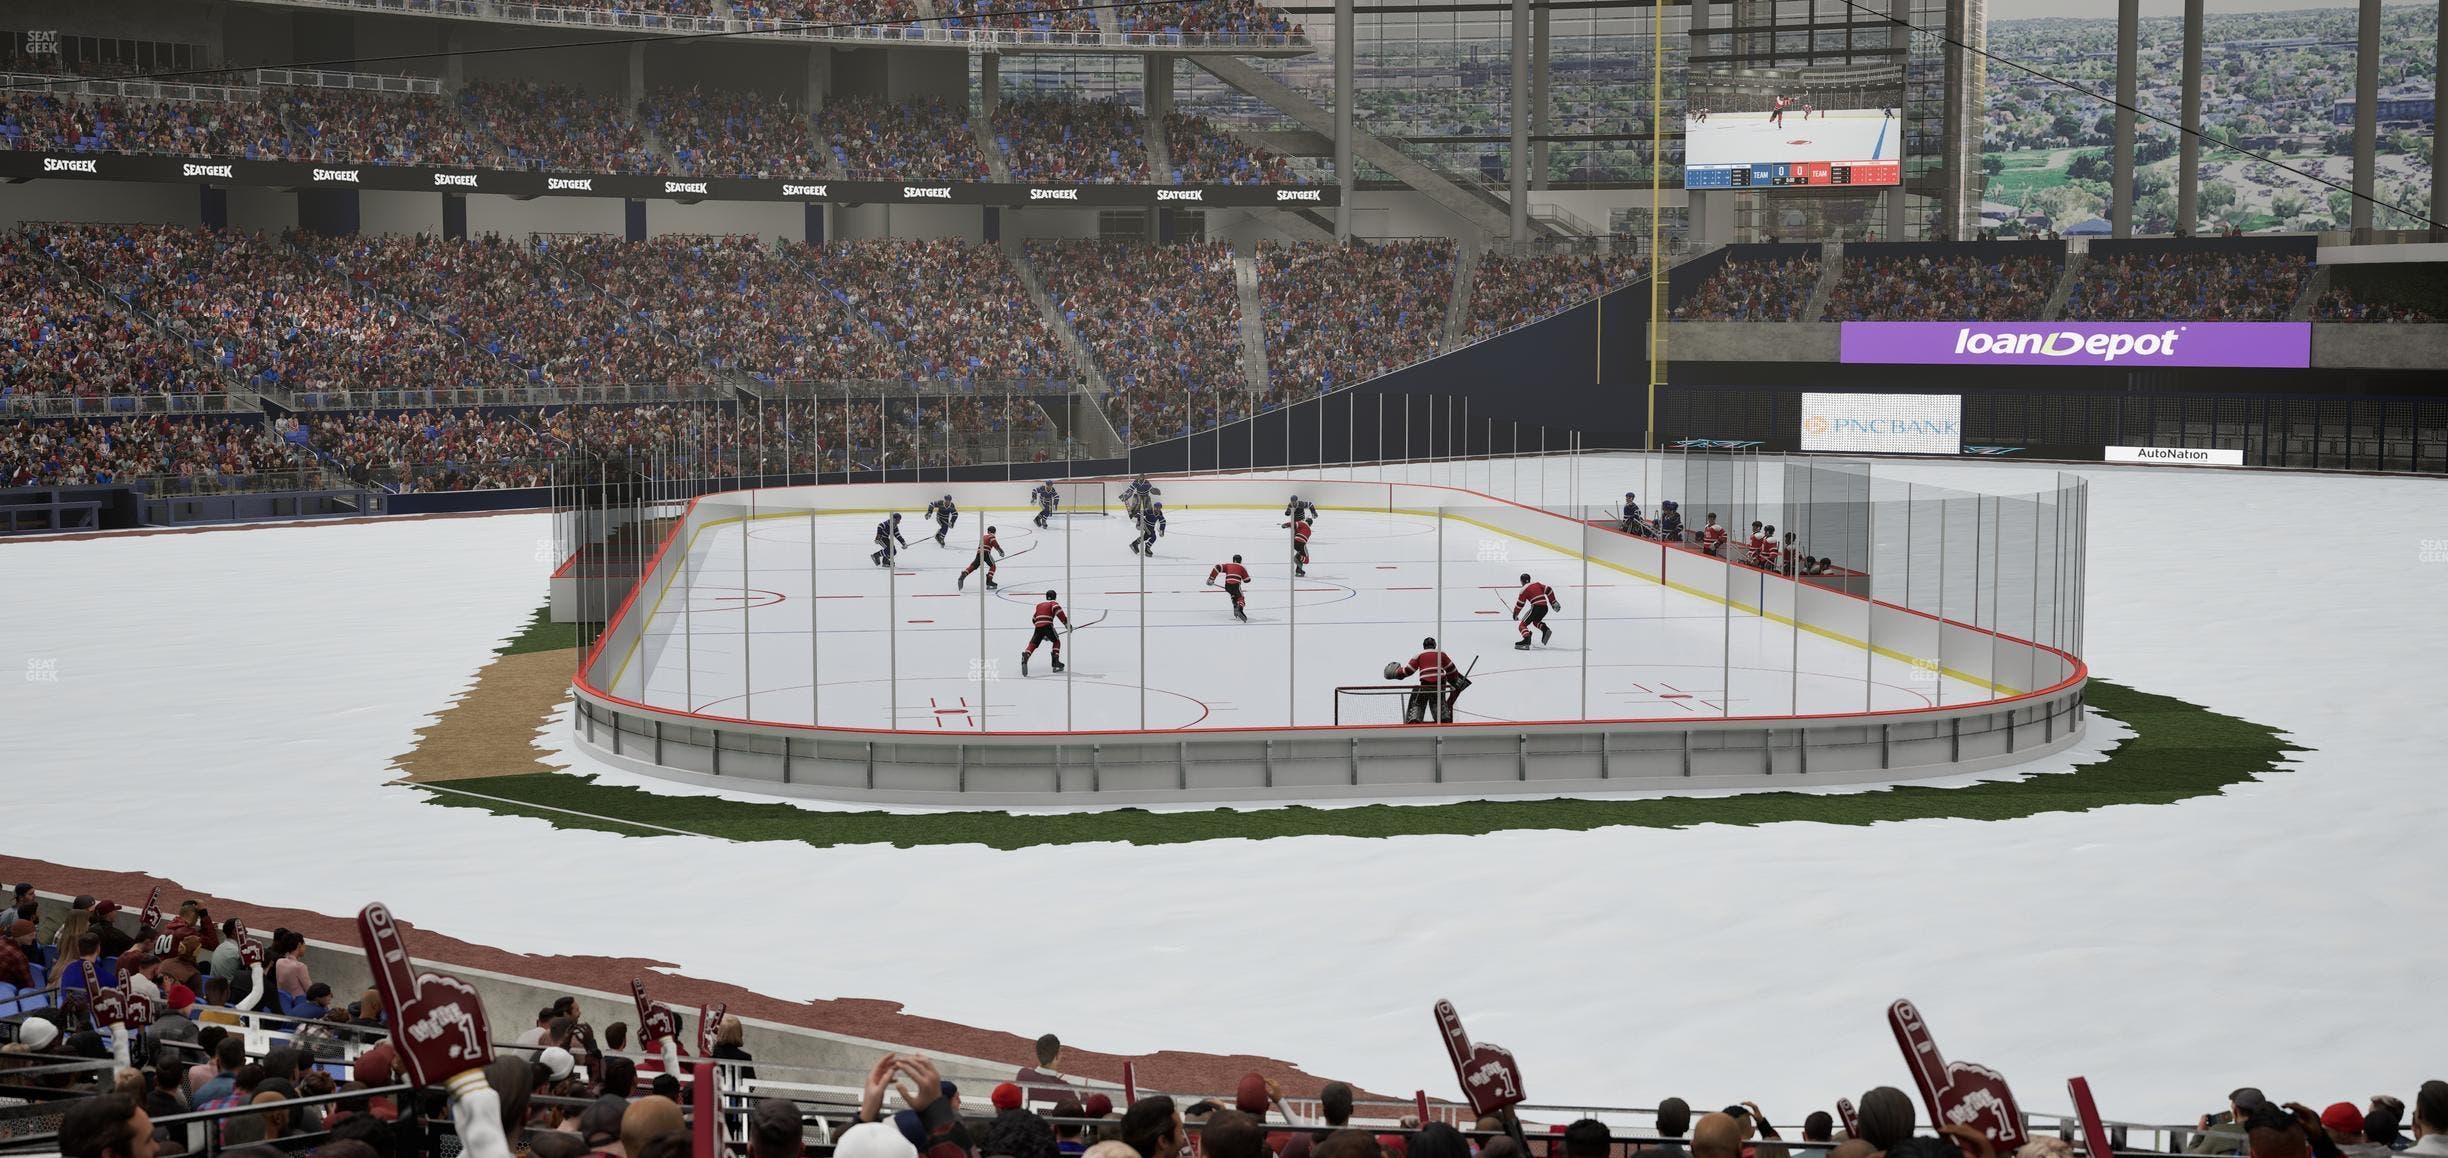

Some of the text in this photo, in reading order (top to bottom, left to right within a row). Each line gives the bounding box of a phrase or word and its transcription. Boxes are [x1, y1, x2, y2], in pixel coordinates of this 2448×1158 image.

[44, 158, 97, 173] SEATGEEK
[183, 164, 232, 178] SEATGEEK
[313, 169, 359, 183] SEATGEEK
[434, 173, 477, 187] SEATGEEK
[1753, 171, 1768, 179] TEAM
[548, 178, 592, 191] SEATGEEK
[665, 181, 707, 194] SEATGEEK
[782, 184, 827, 196] SEATGEEK
[904, 187, 951, 199] SEATGEEK
[1030, 188, 1077, 200] SEATGEEK
[1157, 190, 1202, 201] SEATGEEK
[1277, 190, 1320, 201] SEATGEEK
[1955, 328, 2178, 361] loanDepot
[1834, 418, 1959, 434] PNC BANK
[2138, 448, 2208, 460] AutoNation
[154, 934, 174, 955] 00
